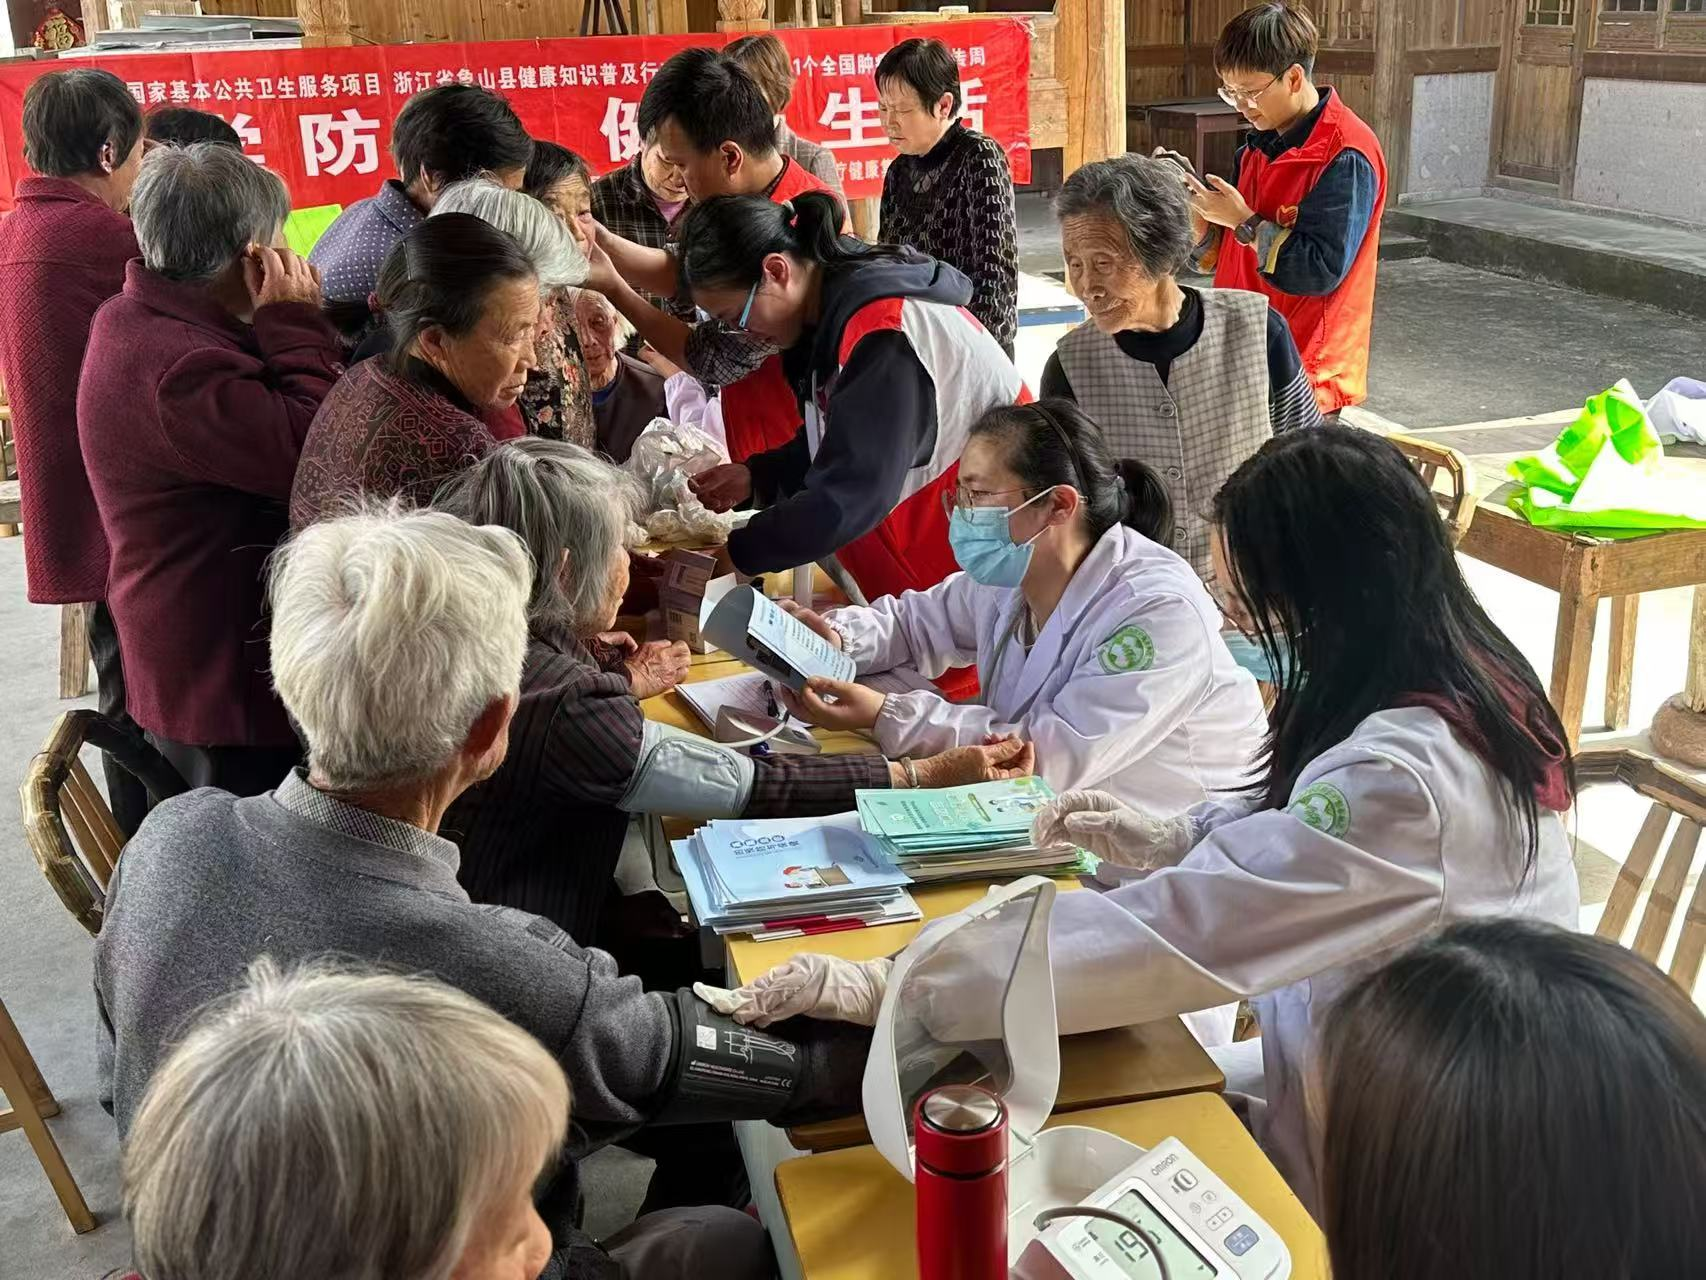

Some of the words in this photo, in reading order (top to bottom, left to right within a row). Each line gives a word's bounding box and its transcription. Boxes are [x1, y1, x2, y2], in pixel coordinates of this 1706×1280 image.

[127, 73, 381, 104] 国家基本公共卫生服务项目
[393, 61, 664, 94] 浙江省象山县健康知识普及行
